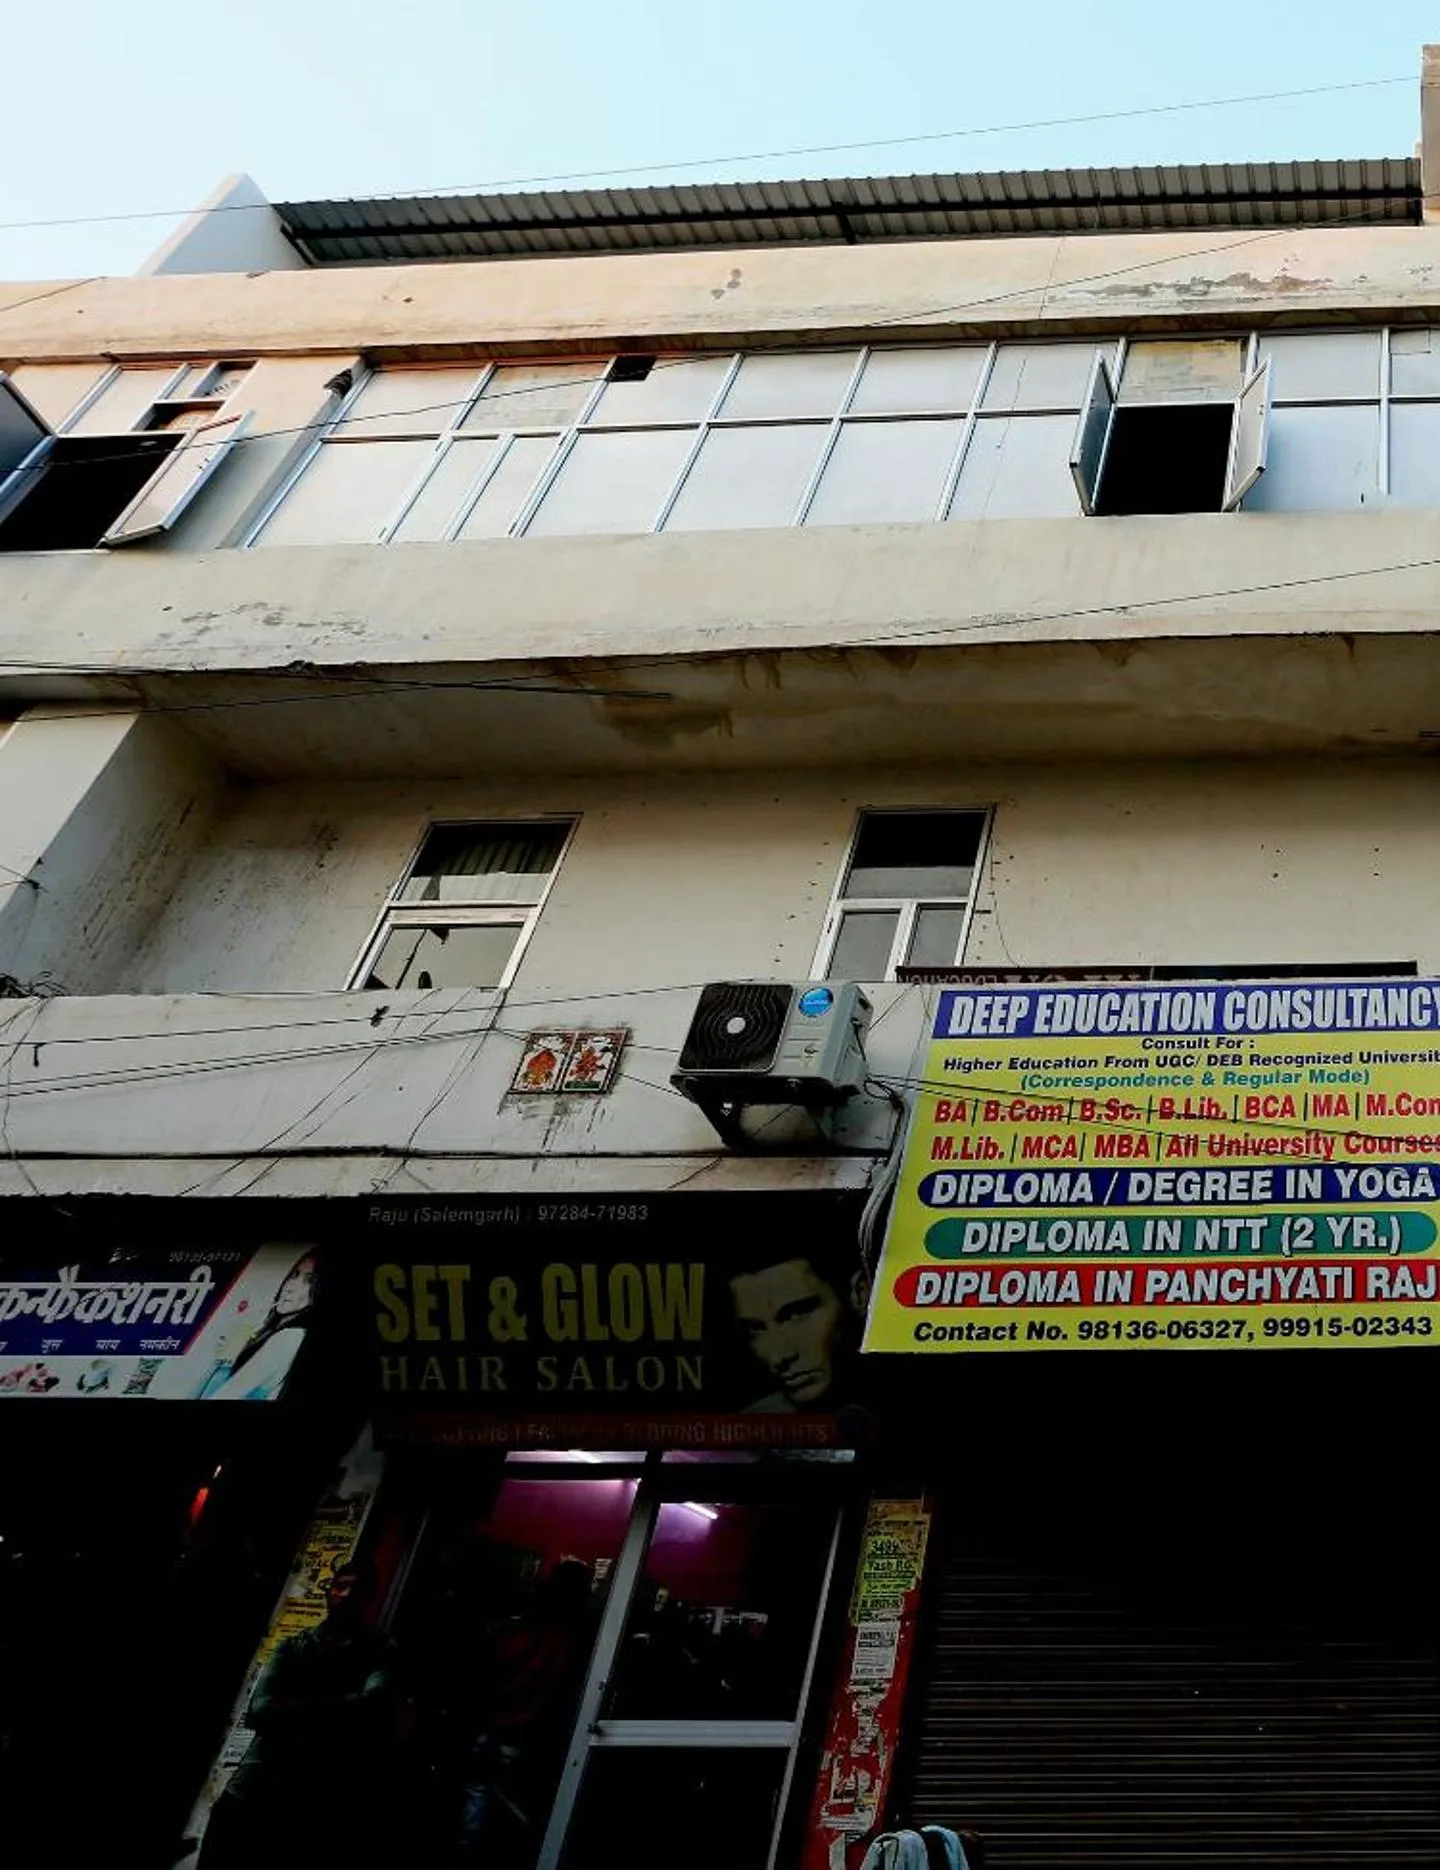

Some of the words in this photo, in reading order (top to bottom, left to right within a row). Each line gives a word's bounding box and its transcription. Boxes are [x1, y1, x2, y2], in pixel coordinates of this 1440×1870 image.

[948, 995, 1030, 1036] DEEP
[1033, 991, 1217, 1035] EDUCATION
[1141, 1036, 1211, 1050] Consult
[1216, 1036, 1245, 1050] For
[943, 1057, 1003, 1074] Higher
[1008, 1055, 1098, 1071] Education
[1104, 1054, 1150, 1070] From
[1207, 1053, 1243, 1067] DEB
[1249, 1051, 1354, 1069] Recognized
[1021, 1072, 1195, 1091] (Correspondence
[1201, 1072, 1217, 1086] &
[1223, 1069, 1303, 1089] Regular
[1308, 1067, 1371, 1087] Mode)
[1244, 1094, 1297, 1120] BCA
[1312, 1093, 1351, 1118] MA
[1094, 1134, 1151, 1159] MBA
[1165, 1133, 1199, 1158] All
[1208, 1129, 1336, 1162] University
[931, 1170, 1096, 1204] DIPLOMA
[1128, 1168, 1274, 1203] DEGREE
[1286, 1167, 1322, 1201] IN
[1336, 1166, 1438, 1200] YOGA
[368, 1206, 409, 1226] Raju
[961, 1218, 1132, 1255] DIPLOMA
[1142, 1217, 1185, 1253] IN
[1194, 1217, 1268, 1252] NTT
[1281, 1217, 1315, 1257] (2
[1325, 1215, 1402, 1256] YR.)
[373, 1262, 472, 1343] SET
[487, 1274, 529, 1343] &
[541, 1261, 706, 1343] GLOW
[914, 1268, 1082, 1306] DIPLOMA
[1094, 1268, 1136, 1304] IN
[1144, 1265, 1355, 1303] PANCHYATI
[1366, 1265, 1438, 1300] RAJ
[913, 1320, 1019, 1343] Contact
[1026, 1320, 1069, 1342] No.
[1077, 1318, 1256, 1343] 98136-06327,
[1262, 1316, 1433, 1338] 99915-02343
[380, 1355, 511, 1393] HAIR
[536, 1354, 705, 1393] SALON
